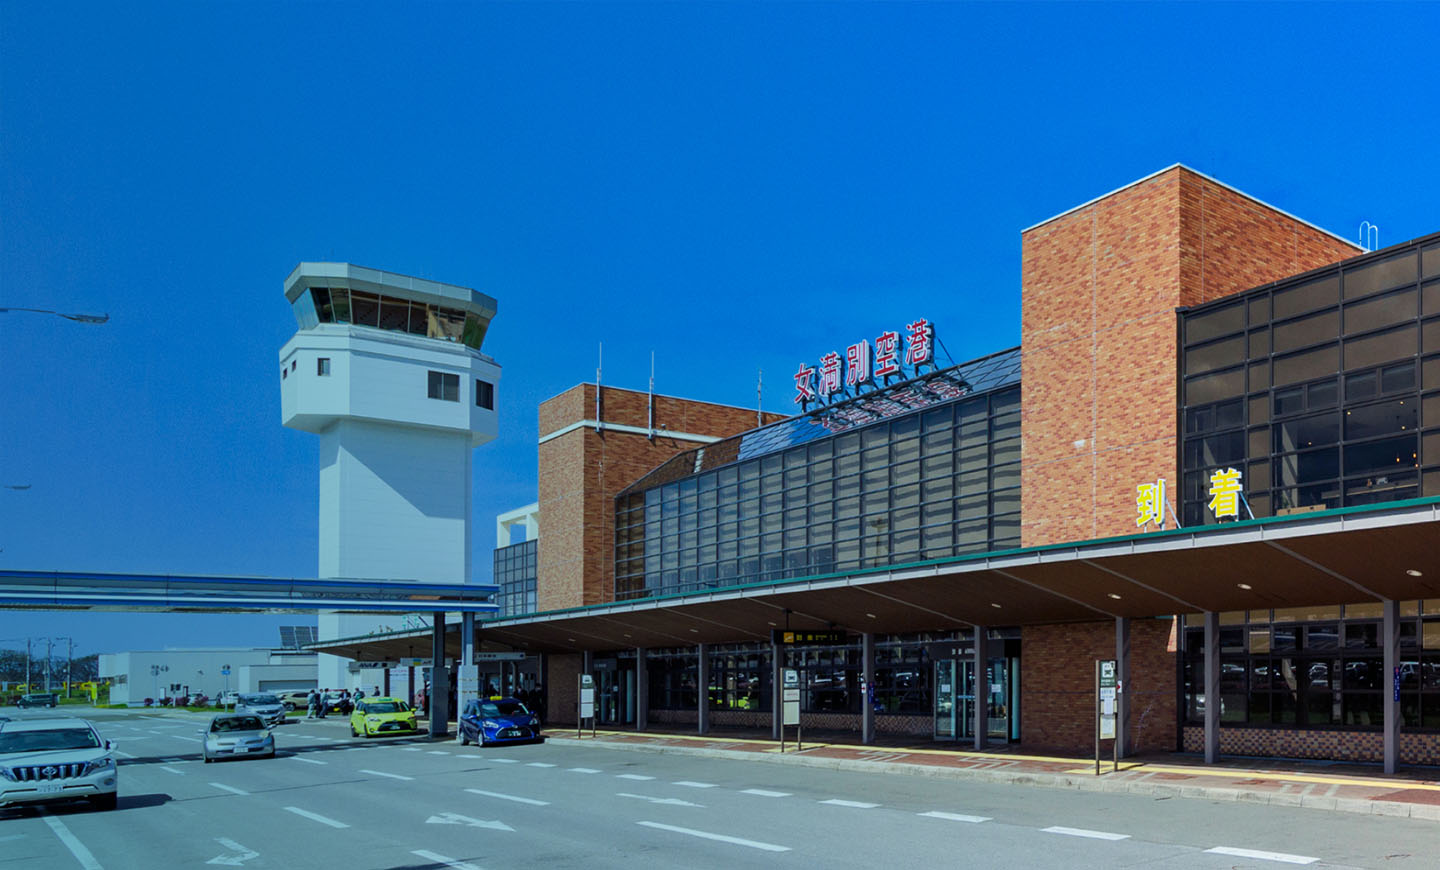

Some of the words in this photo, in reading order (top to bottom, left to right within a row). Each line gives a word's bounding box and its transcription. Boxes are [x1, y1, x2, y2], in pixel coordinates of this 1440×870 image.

[794, 317, 928, 403] 女満別空港
